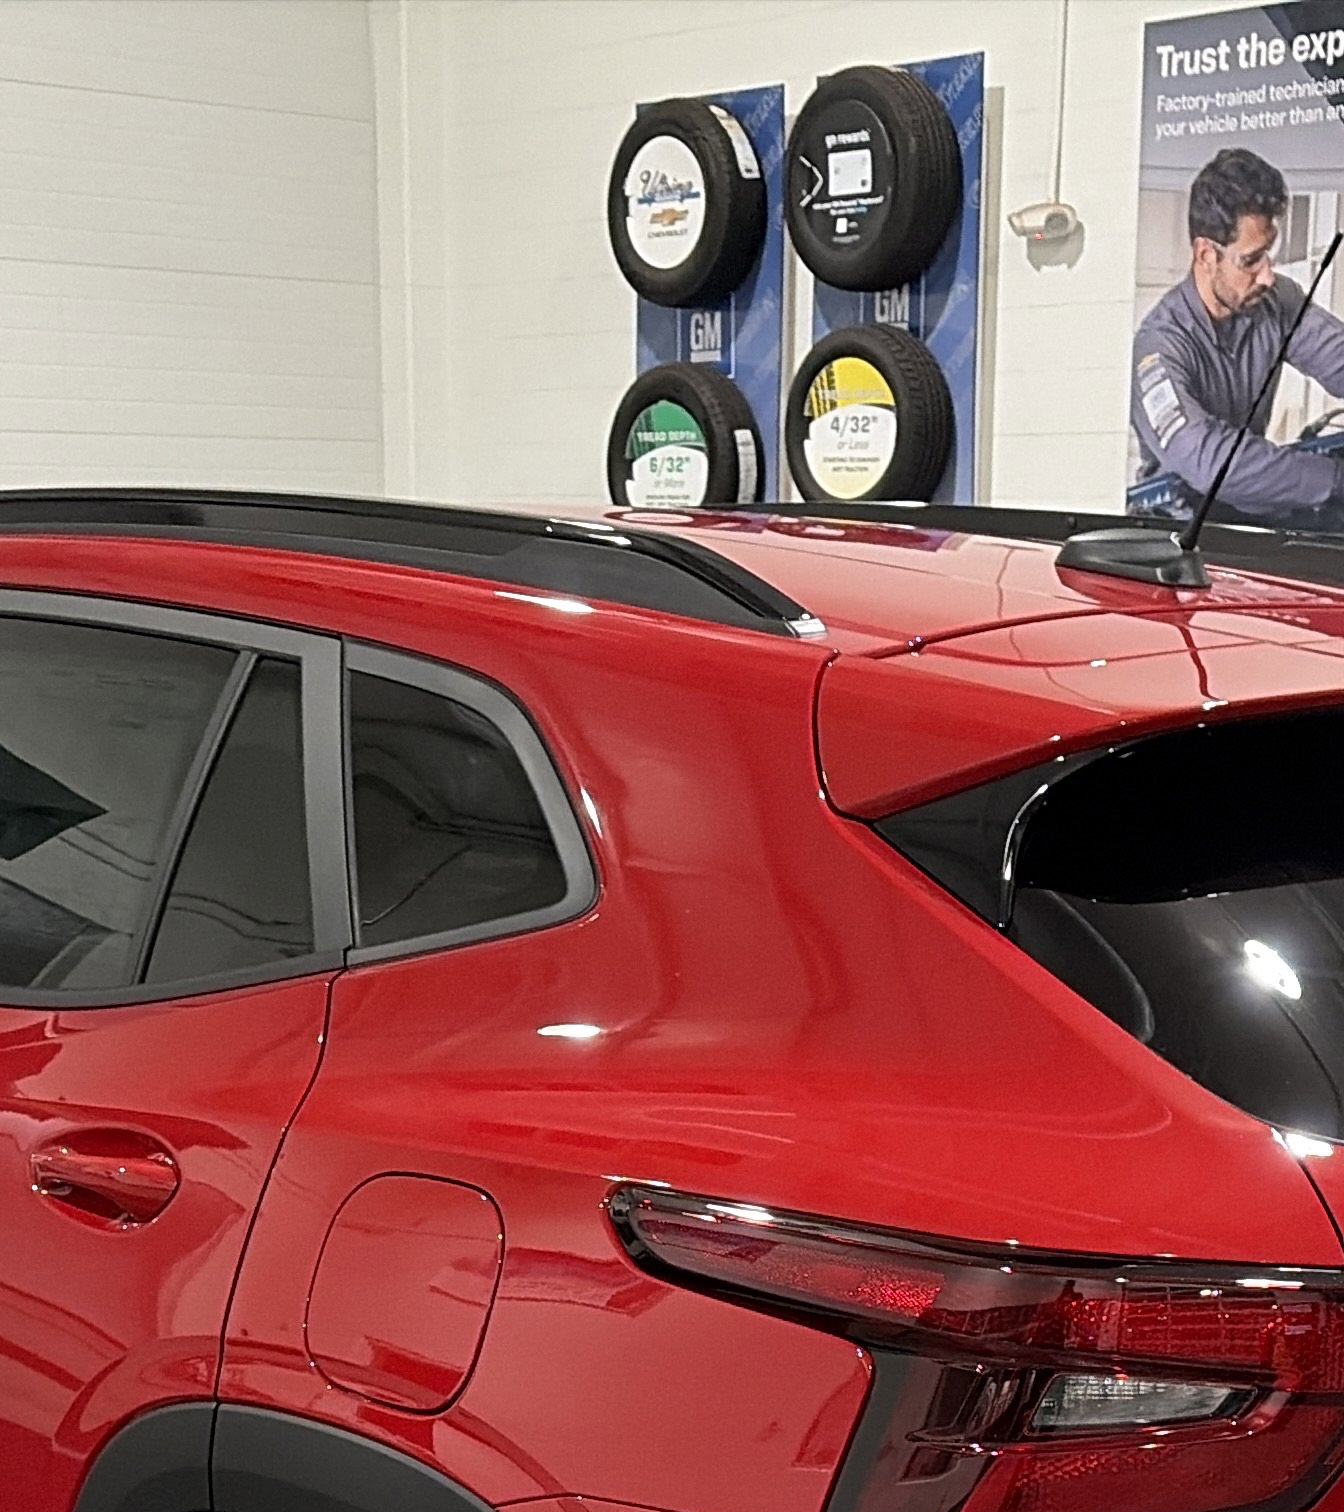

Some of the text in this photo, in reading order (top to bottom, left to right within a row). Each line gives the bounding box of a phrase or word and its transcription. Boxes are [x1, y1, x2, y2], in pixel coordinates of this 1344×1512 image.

[1156, 39, 1230, 78] Trust
[1238, 32, 1285, 68] the
[1157, 83, 1266, 113] Factory-trained
[1155, 118, 1187, 141] your
[1188, 111, 1238, 135] vehicle
[1240, 108, 1286, 131] better
[1289, 103, 1323, 125] than
[875, 283, 909, 323] GM
[690, 312, 721, 352] GM
[830, 415, 878, 438] 4/32"
